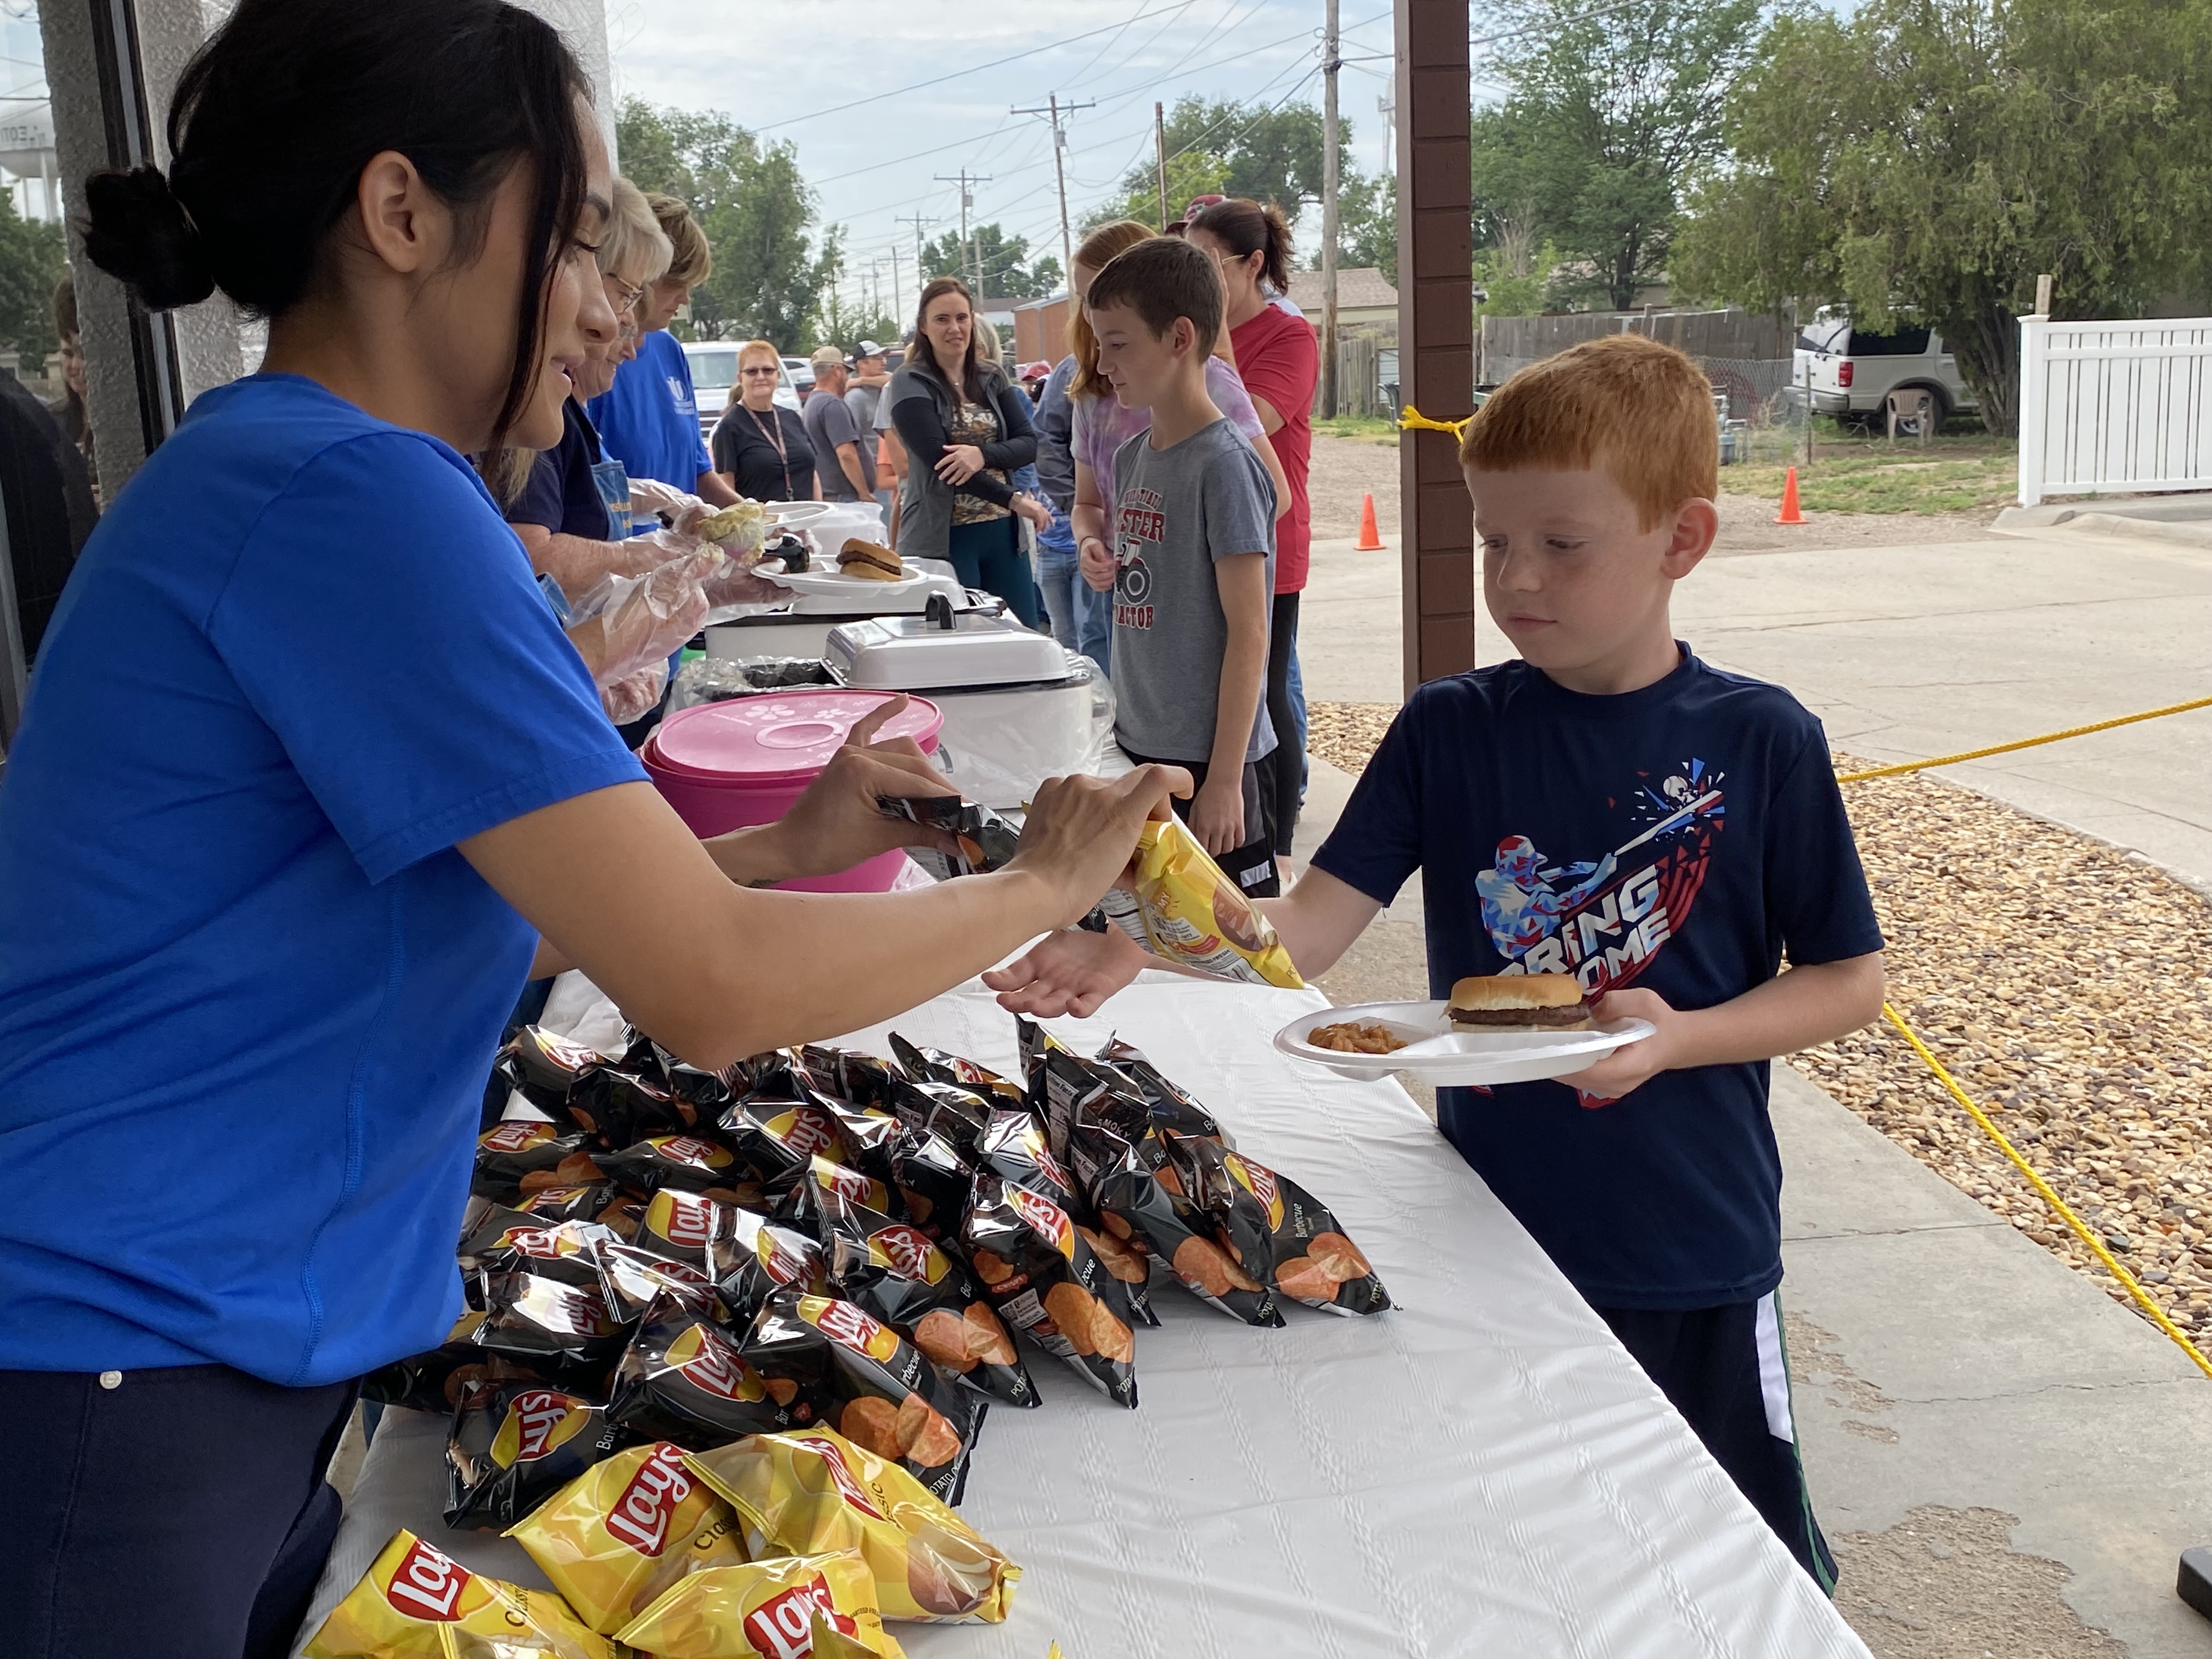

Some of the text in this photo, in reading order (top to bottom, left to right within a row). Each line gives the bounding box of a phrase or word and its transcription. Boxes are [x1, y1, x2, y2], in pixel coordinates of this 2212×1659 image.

[1578, 906, 1671, 996] OME
[786, 1109, 832, 1154] ay's
[1097, 1118, 1132, 1140] SMOKY
[996, 1278, 1024, 1291] CRISPY
[610, 1445, 691, 1552] Lay's
[929, 1472, 953, 1496] OTATO
